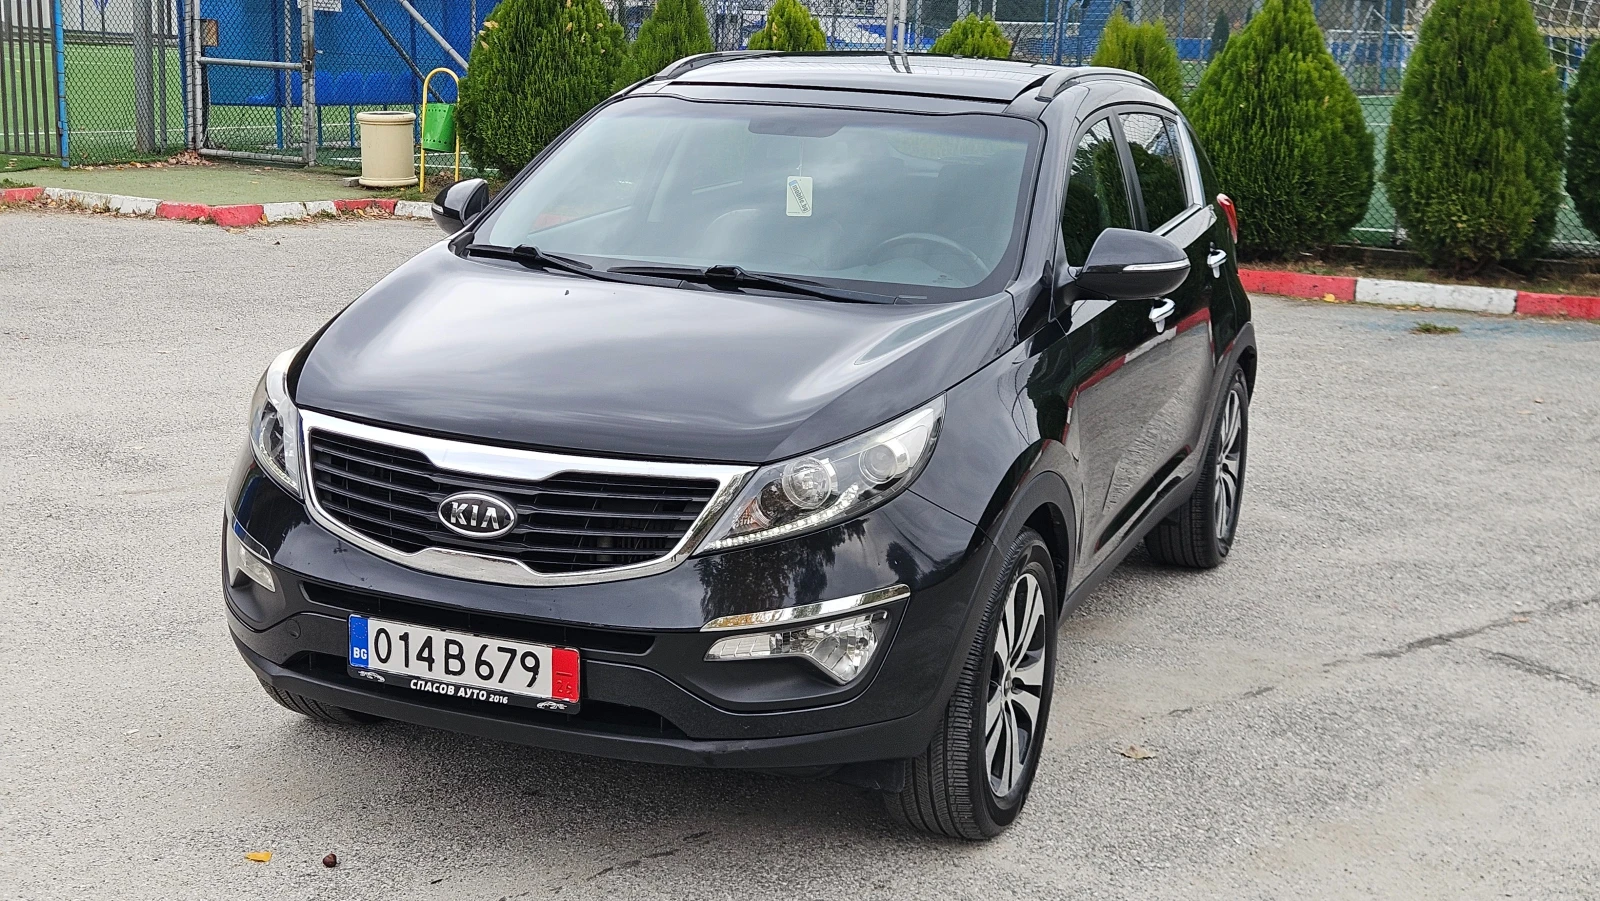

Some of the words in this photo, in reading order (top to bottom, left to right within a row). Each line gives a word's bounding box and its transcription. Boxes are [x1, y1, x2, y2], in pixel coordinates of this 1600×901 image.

[449, 501, 500, 530] KIA
[353, 647, 367, 660] BG
[373, 627, 541, 688] 014B679
[410, 679, 455, 695] СПАСОВ
[458, 687, 487, 701] АУТО
[489, 694, 509, 704] 2016
